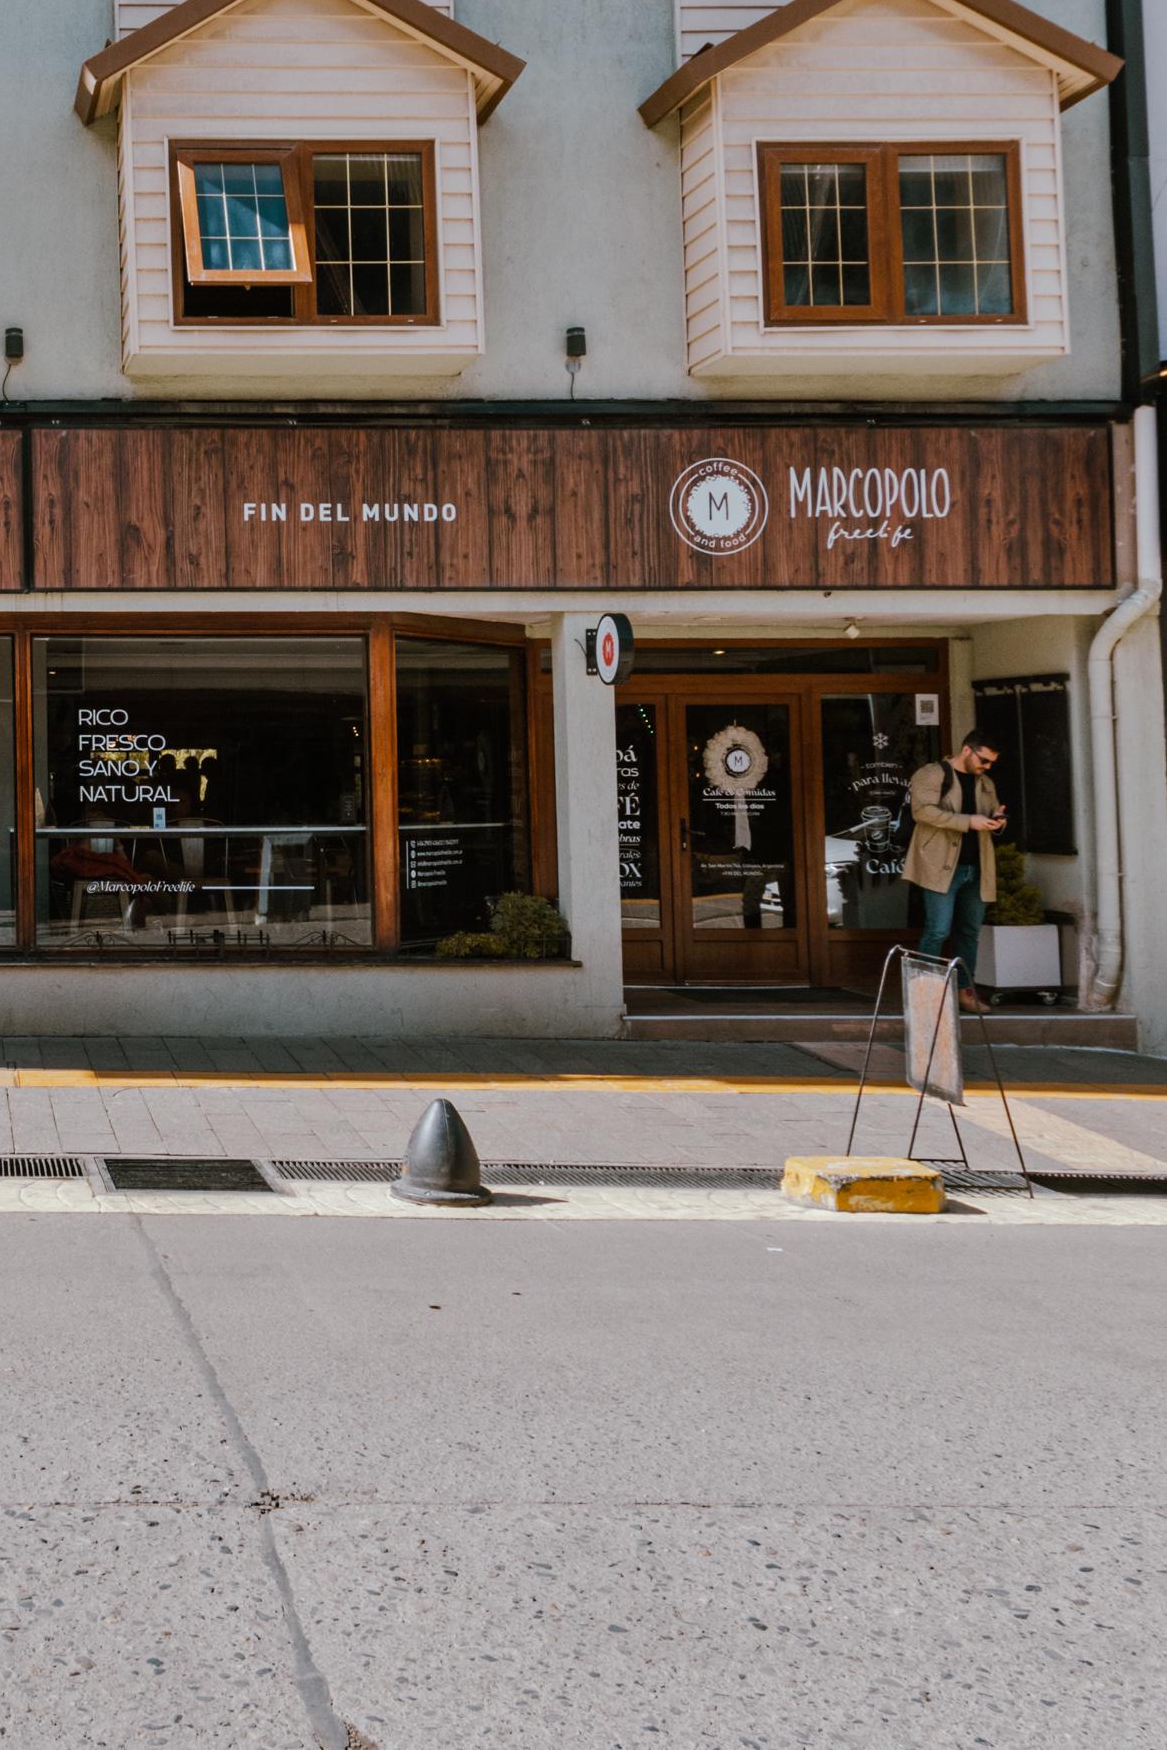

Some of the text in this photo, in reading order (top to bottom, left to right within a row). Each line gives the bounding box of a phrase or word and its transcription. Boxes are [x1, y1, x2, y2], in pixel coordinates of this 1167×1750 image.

[698, 462, 738, 476] coffee
[789, 466, 951, 518] MARCOPOLO
[243, 502, 457, 522] FIN DEL MUNDO
[708, 491, 729, 521] M
[694, 533, 746, 548] and food
[826, 520, 914, 550] freelife
[78, 709, 129, 725] RICO
[78, 734, 166, 751] FRESCO
[78, 760, 158, 777] SANO Y
[734, 756, 743, 766] M
[852, 776, 880, 791] para
[79, 785, 180, 802] NATURAL
[86, 880, 196, 895] @MarcopoloFreelife
